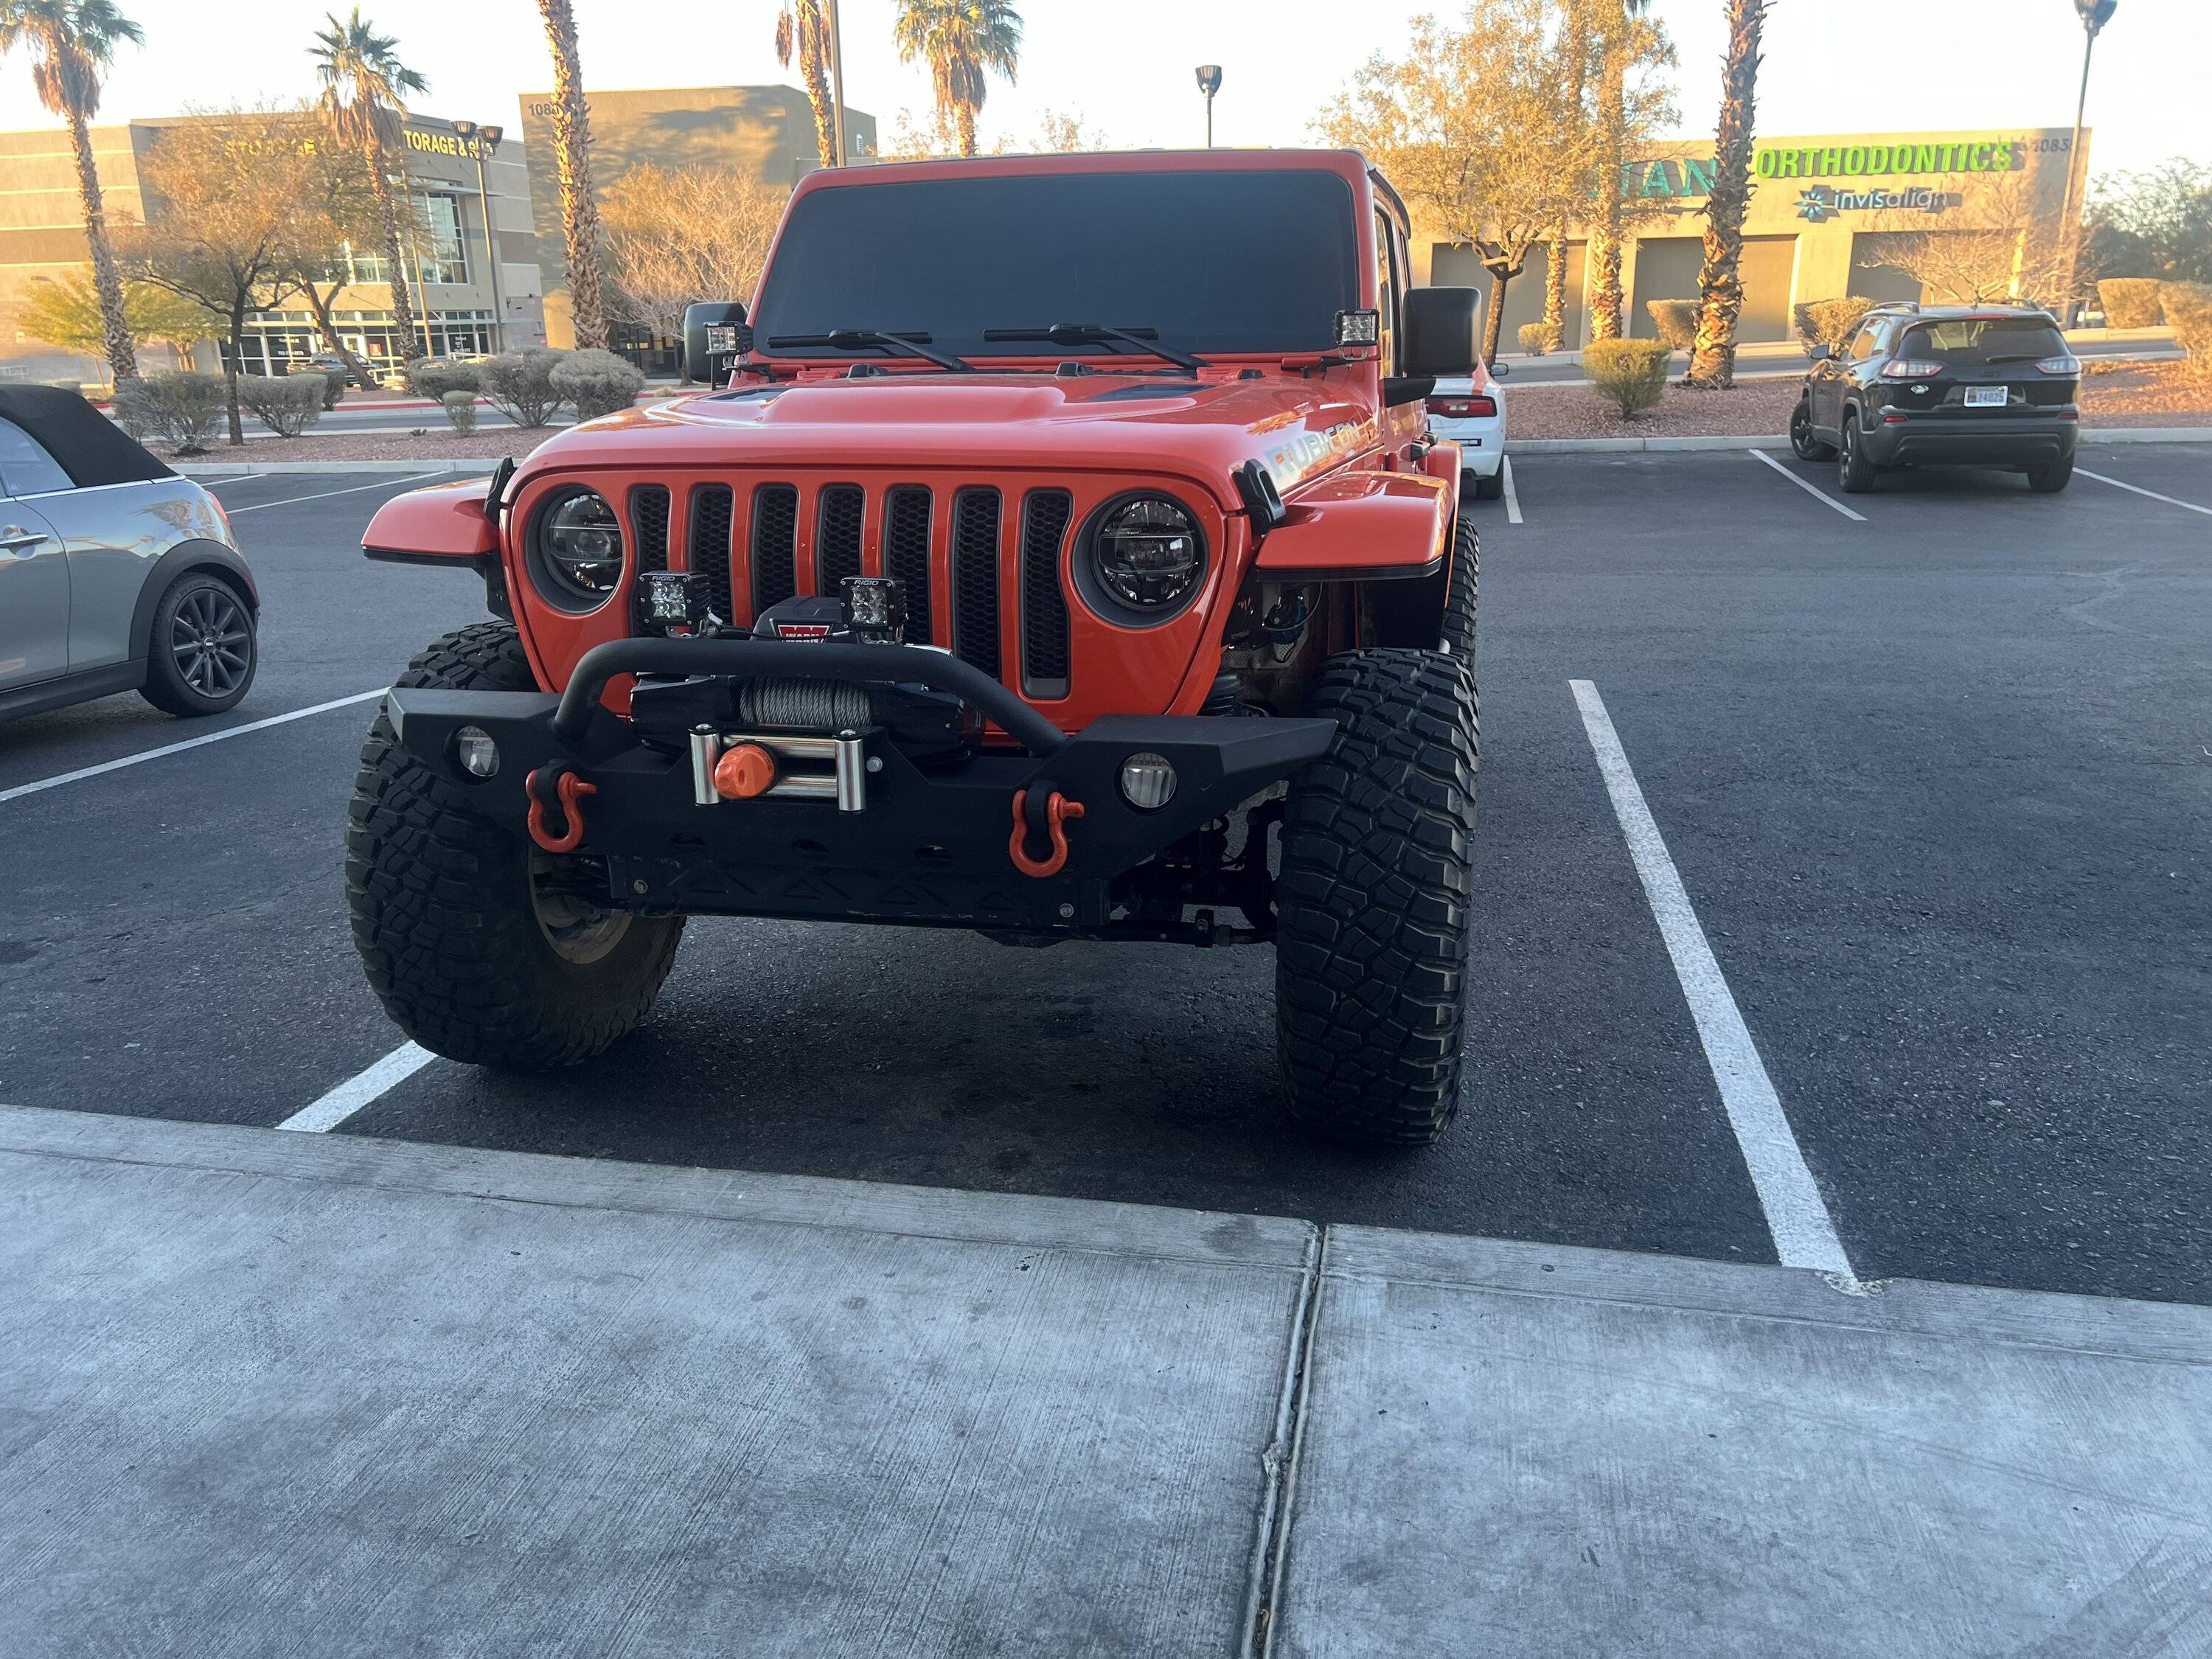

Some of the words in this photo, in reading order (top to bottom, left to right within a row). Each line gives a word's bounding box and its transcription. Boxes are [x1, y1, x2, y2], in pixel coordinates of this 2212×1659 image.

[529, 103, 556, 116] 108
[403, 130, 456, 156] TORAGE
[457, 136, 467, 157] &
[1756, 141, 2011, 178] ORTHODONTICS
[1834, 187, 1947, 212] invisalign
[1264, 418, 1360, 479] RUBICON
